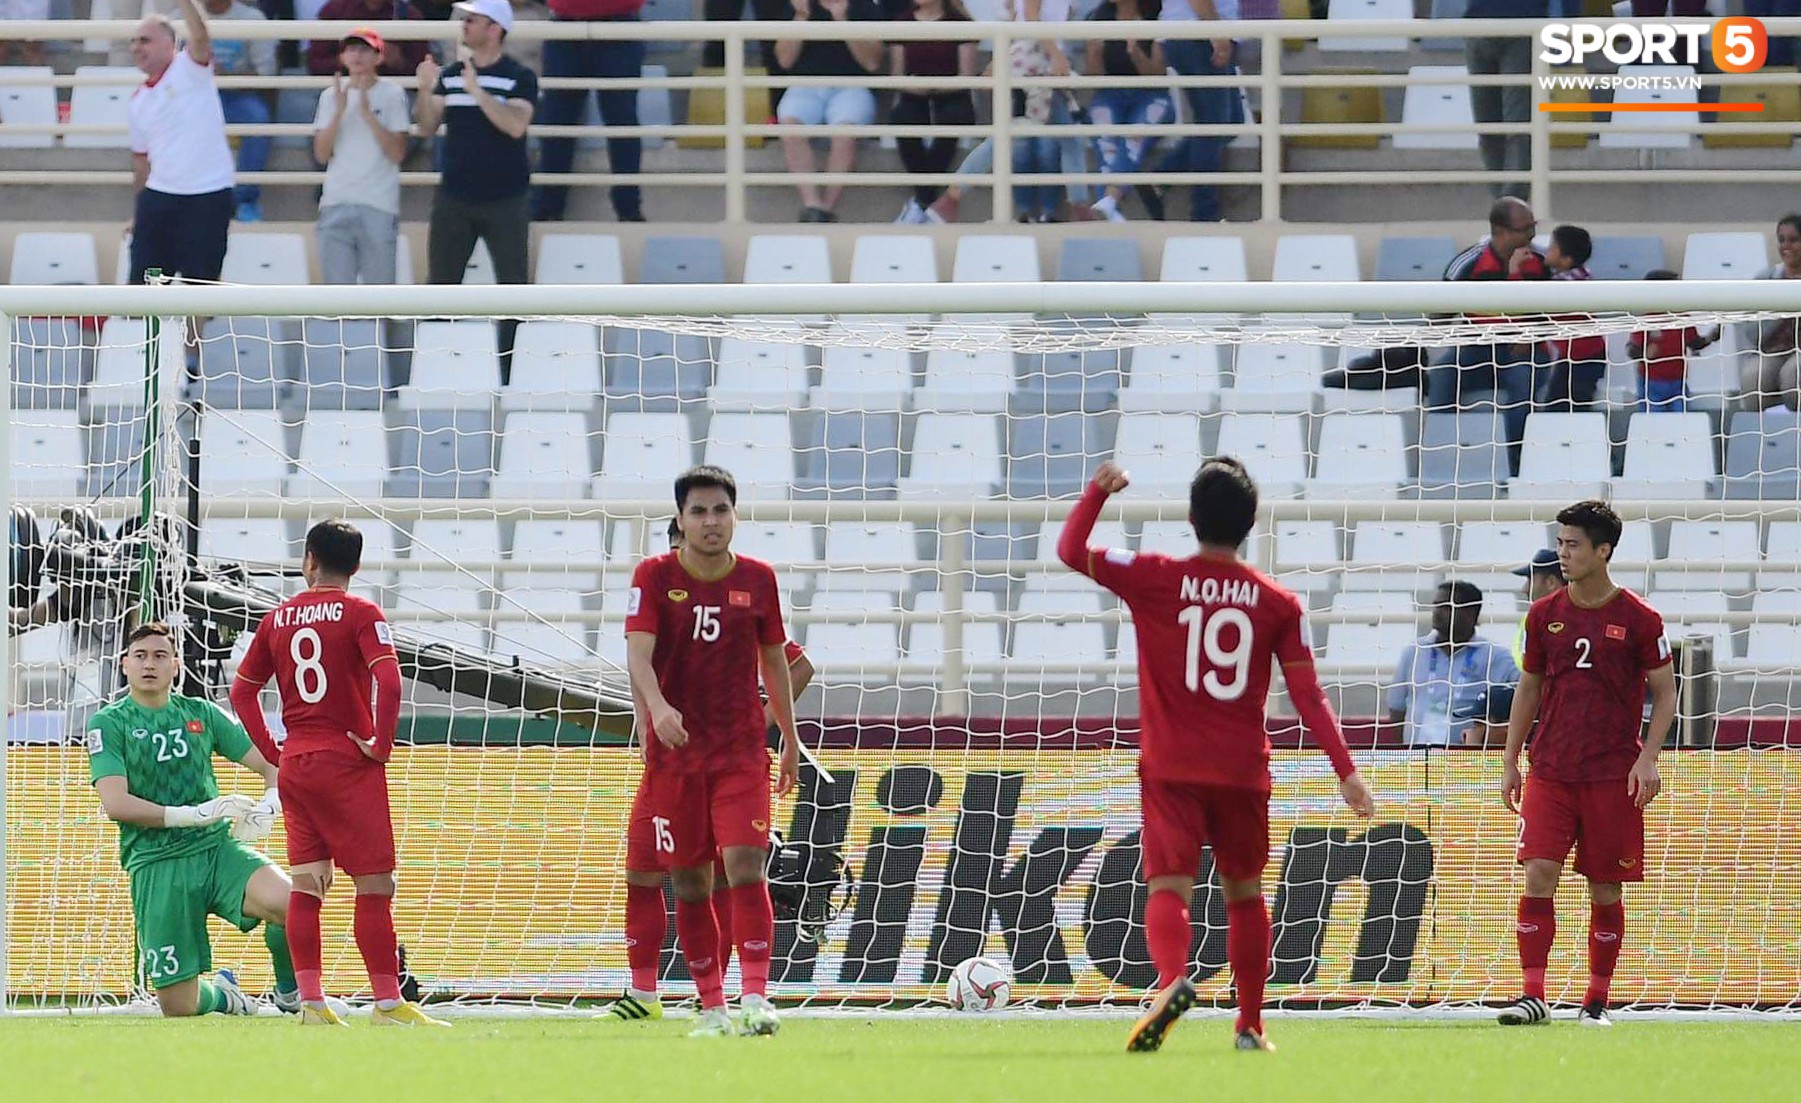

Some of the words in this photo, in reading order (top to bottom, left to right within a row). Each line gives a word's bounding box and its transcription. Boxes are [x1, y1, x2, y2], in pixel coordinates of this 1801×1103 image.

[273, 602, 344, 629] N.T.HOANG
[692, 604, 721, 642] 15
[290, 627, 328, 704] 8
[1177, 605, 1254, 700] 19
[1574, 637, 1593, 669] 2
[152, 728, 188, 762] 23
[652, 815, 675, 853] 15
[146, 945, 179, 977] 23
